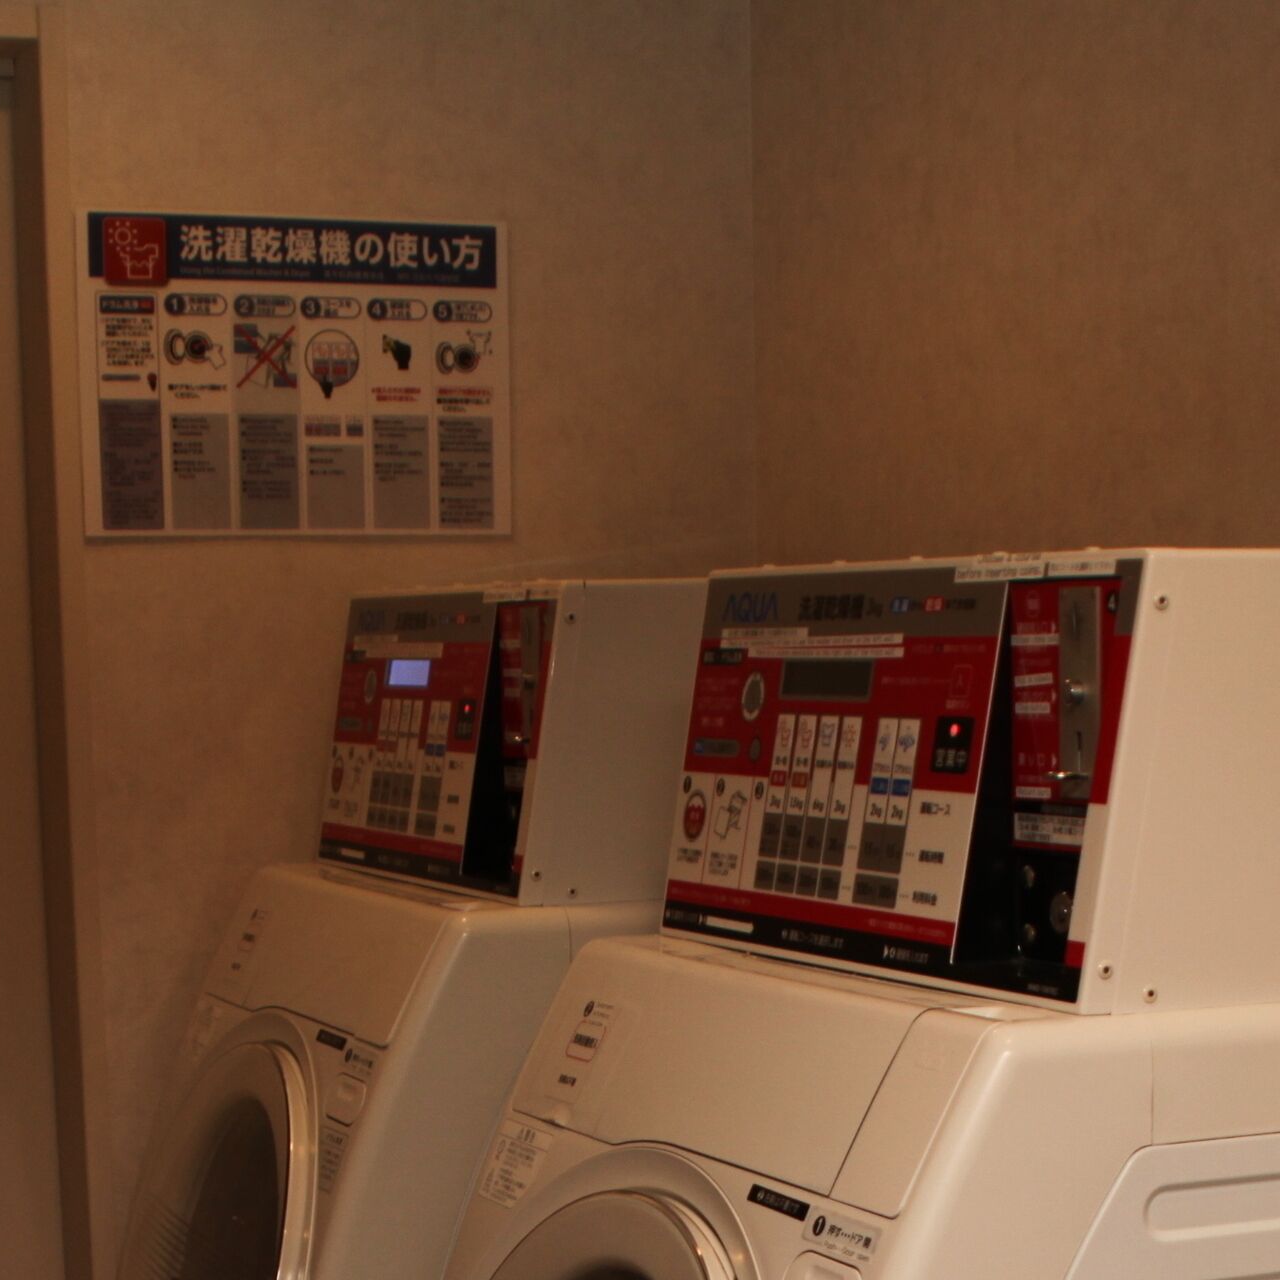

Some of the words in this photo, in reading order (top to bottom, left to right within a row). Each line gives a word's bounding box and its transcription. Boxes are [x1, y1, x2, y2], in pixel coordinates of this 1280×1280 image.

[179, 223, 484, 271] 洗濯乾燥機の使い方
[722, 592, 779, 623] AQUA
